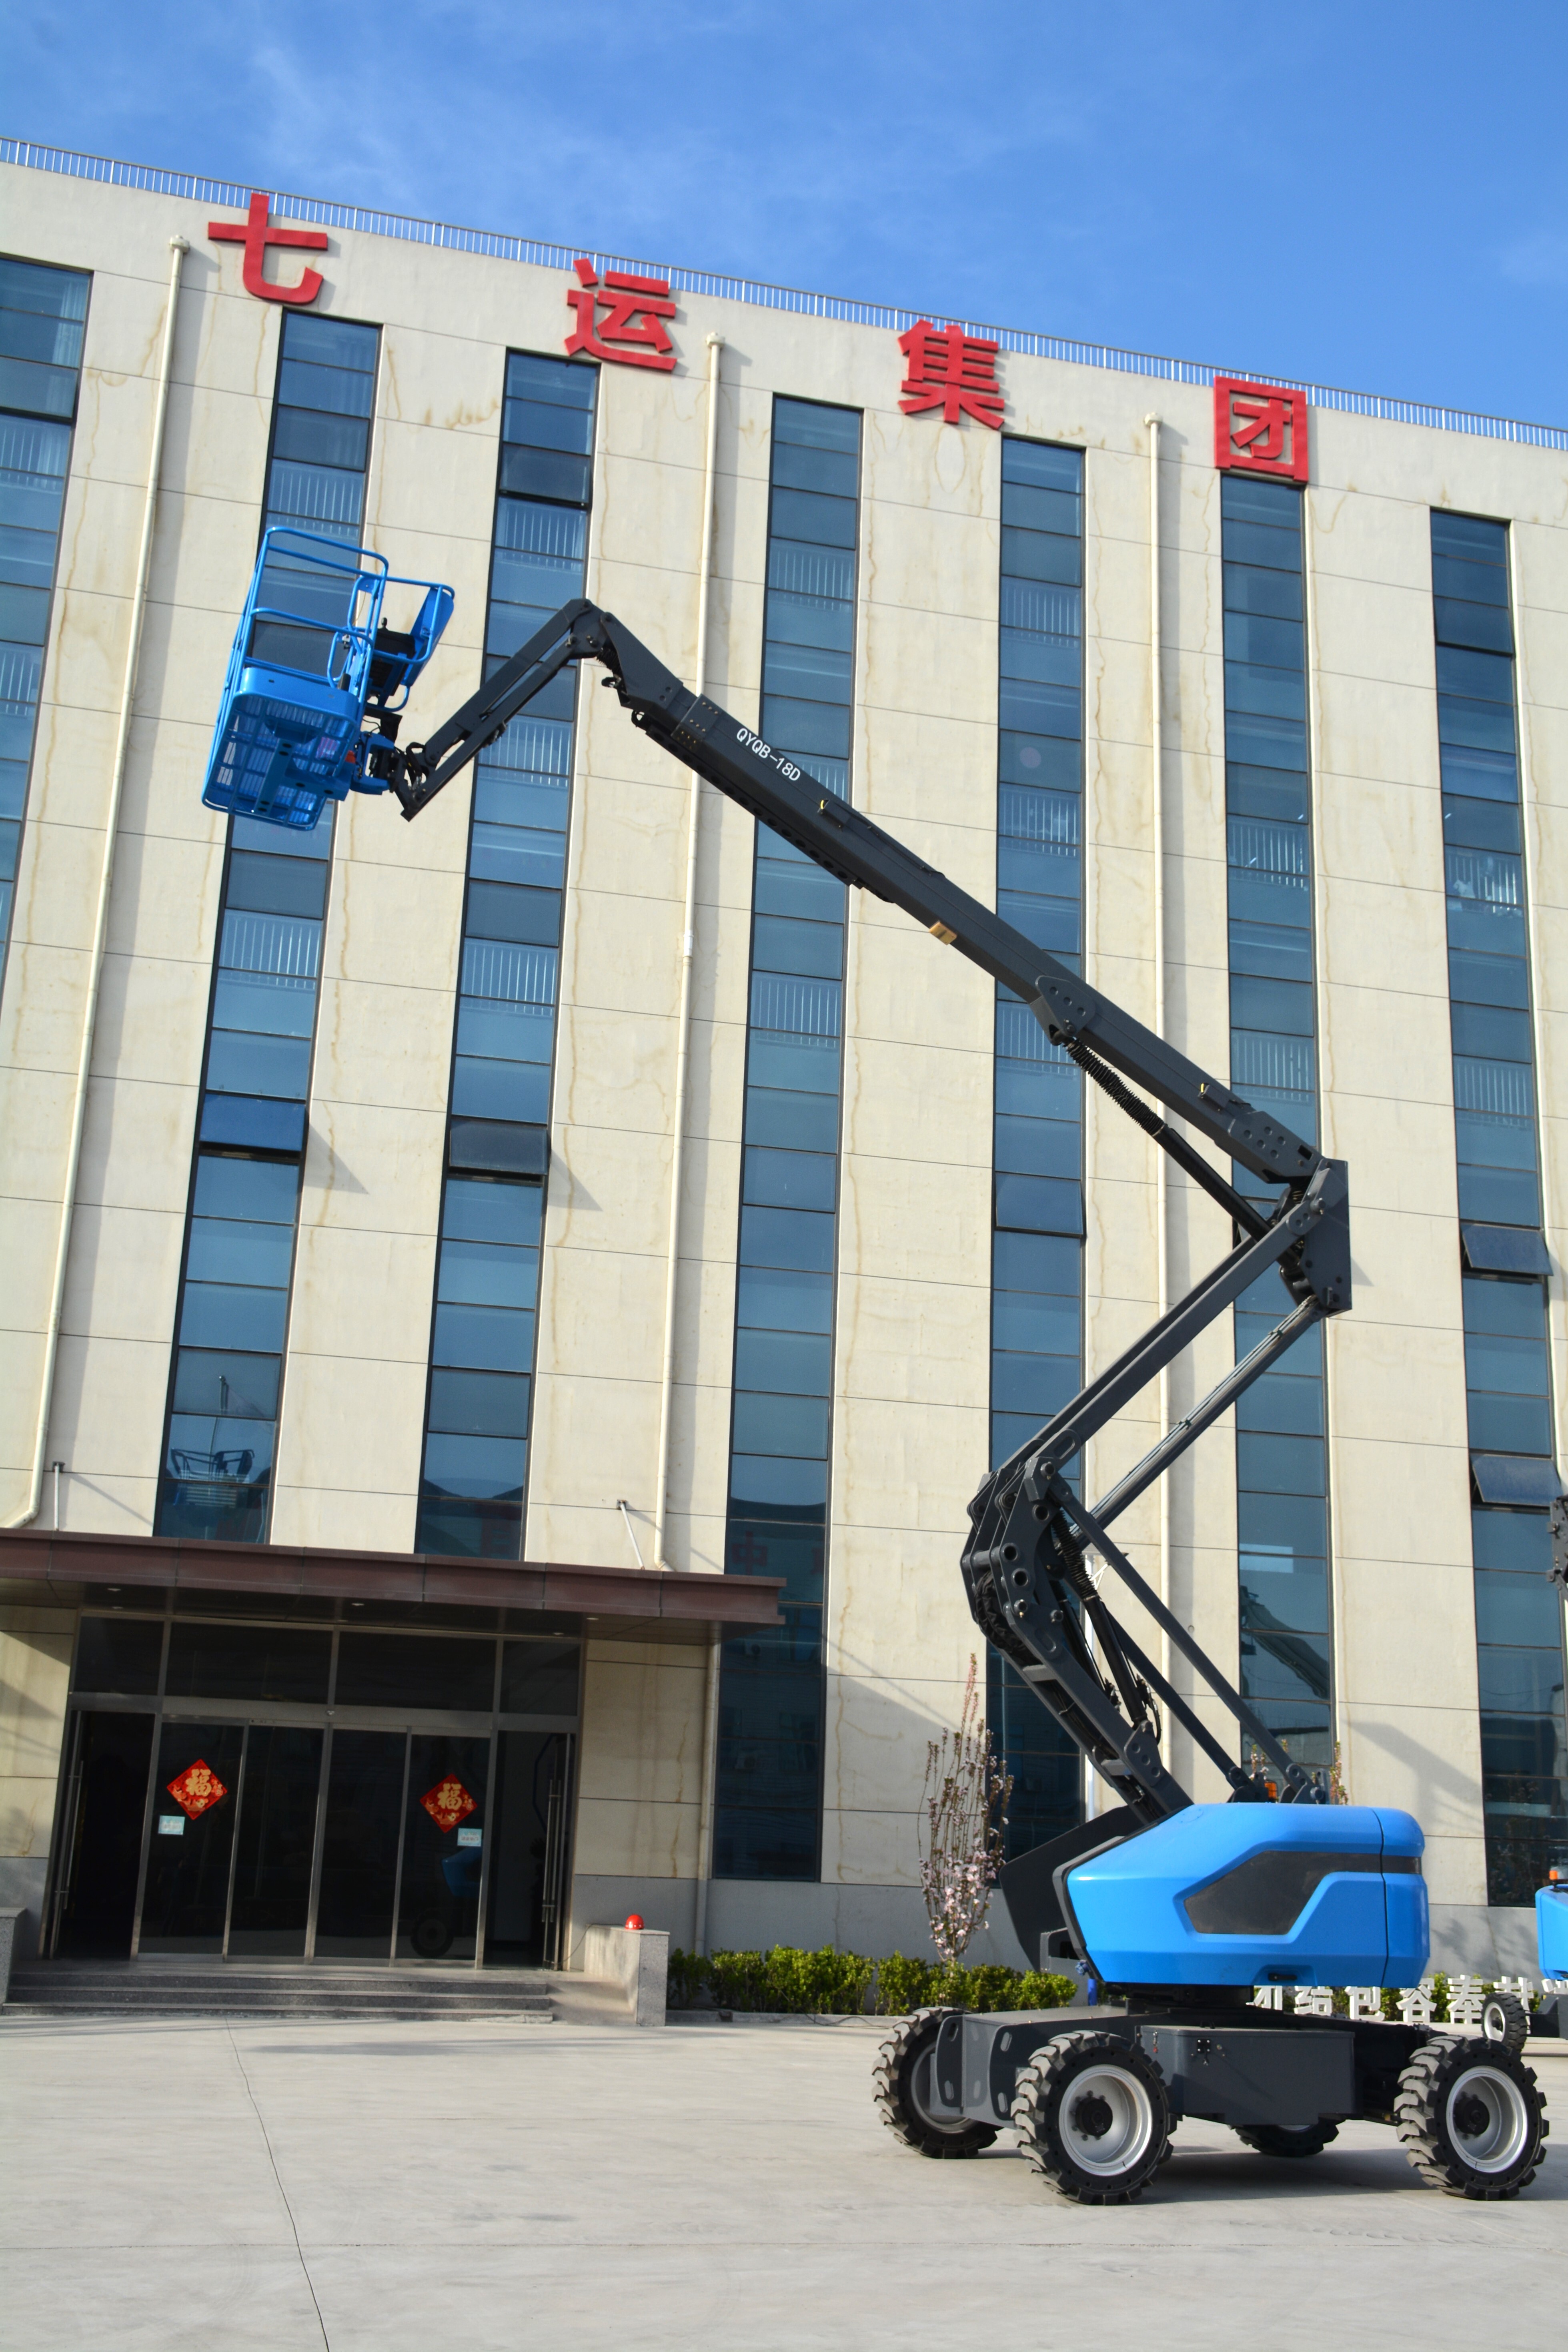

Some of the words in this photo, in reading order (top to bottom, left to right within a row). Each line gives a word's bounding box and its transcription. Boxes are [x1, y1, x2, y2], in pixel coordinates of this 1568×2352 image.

[208, 194, 1309, 483] 七运集团
[736, 728, 801, 781] QYQB-18D
[185, 1769, 212, 1797] 福
[437, 1783, 462, 1811] 福
[1246, 1975, 1568, 2026] 结包容奉
